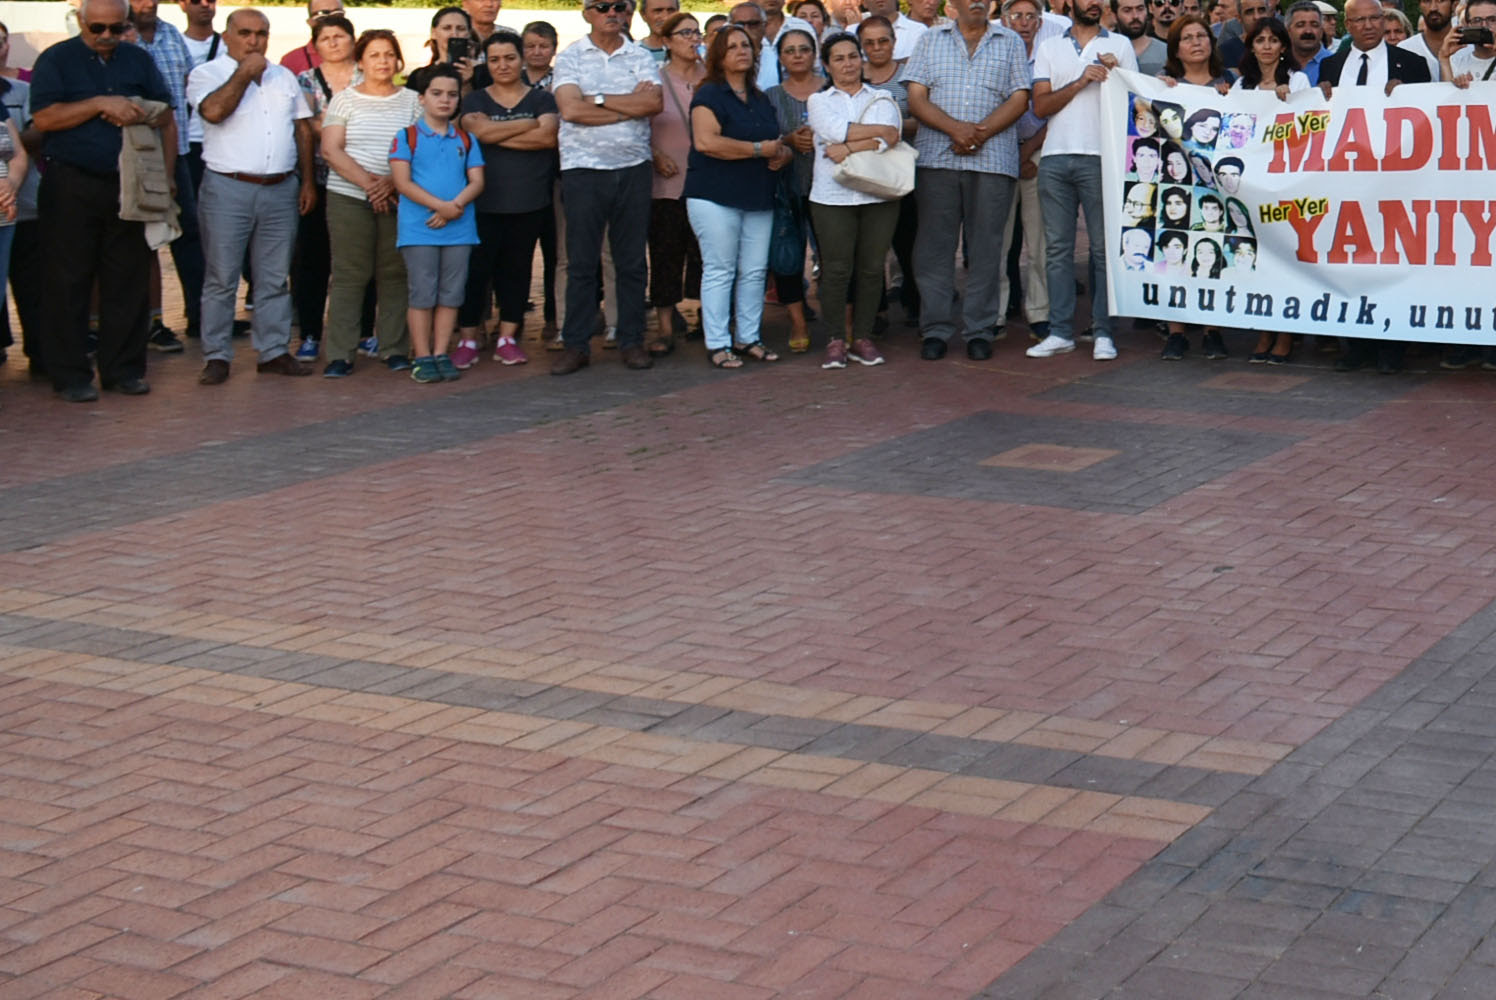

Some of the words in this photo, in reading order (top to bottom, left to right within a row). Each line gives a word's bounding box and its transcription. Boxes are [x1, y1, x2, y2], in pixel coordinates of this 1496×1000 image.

[1262, 122, 1292, 143] Her
[1297, 112, 1329, 134] Yer
[1259, 205, 1291, 223] Her
[1294, 198, 1328, 218] Yer
[1142, 282, 1391, 333] unutmadık,
